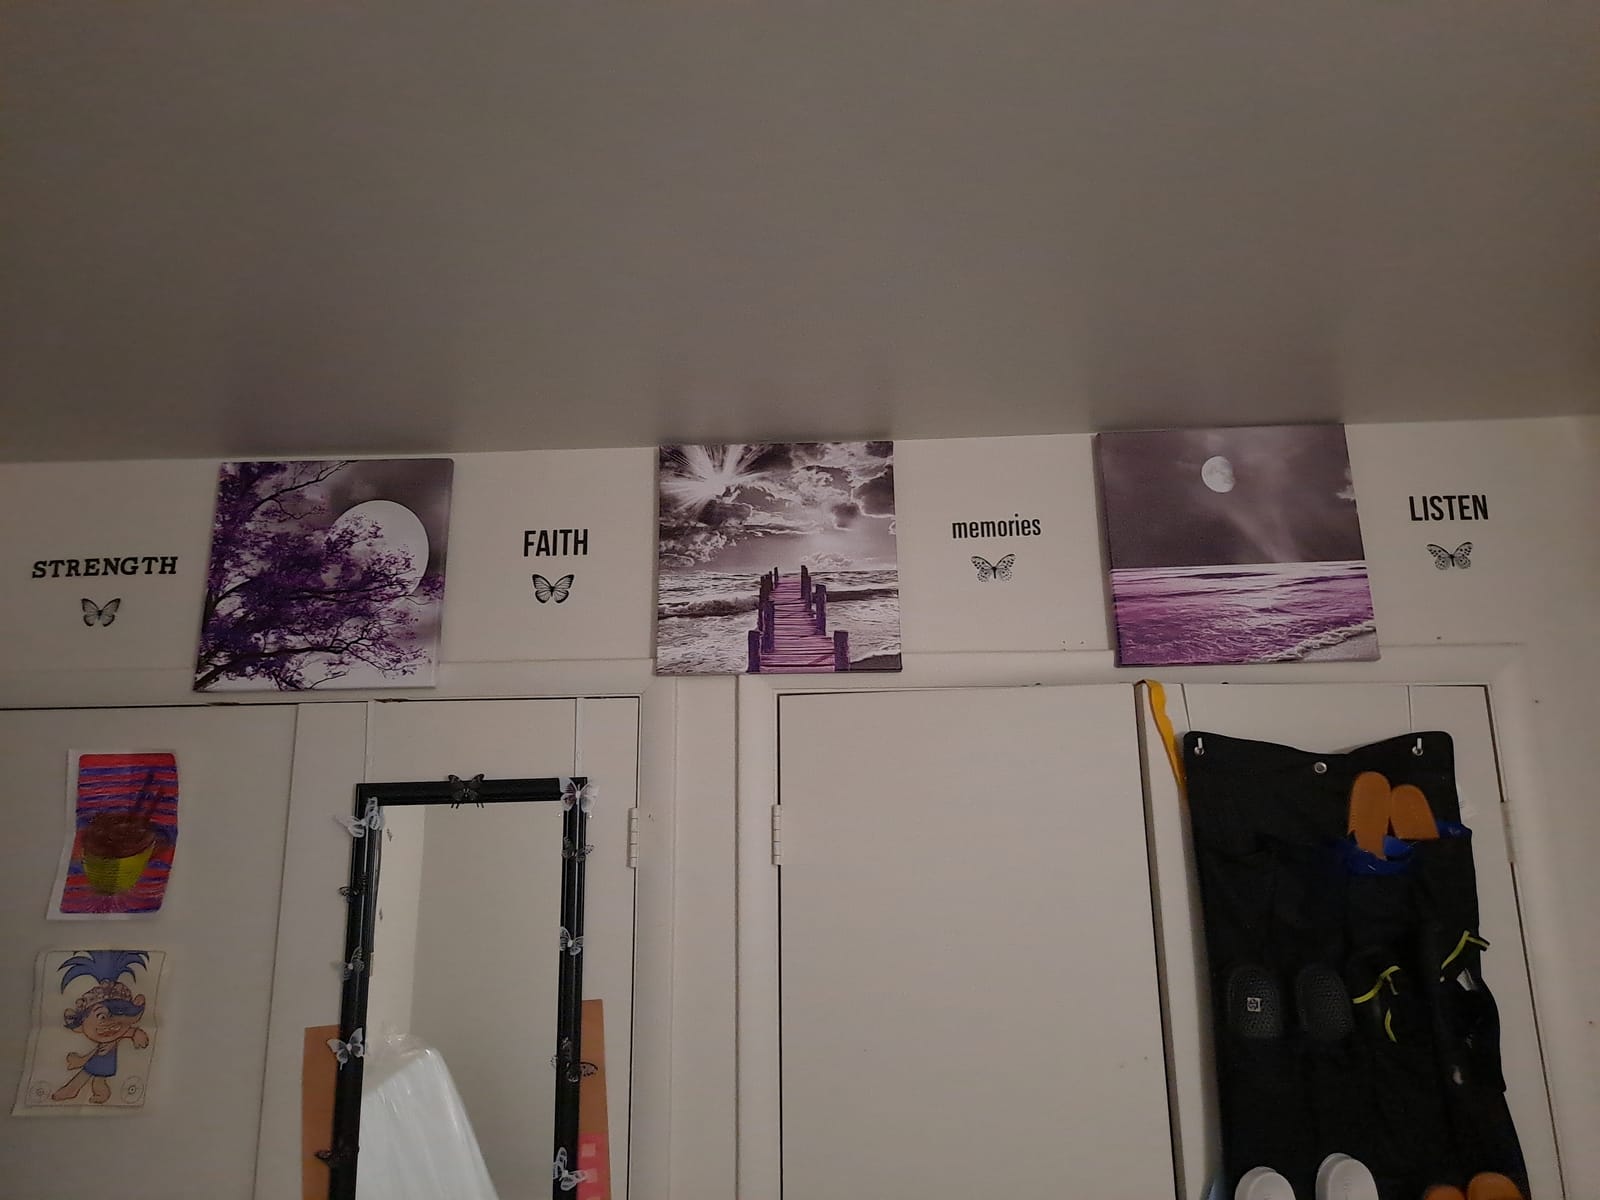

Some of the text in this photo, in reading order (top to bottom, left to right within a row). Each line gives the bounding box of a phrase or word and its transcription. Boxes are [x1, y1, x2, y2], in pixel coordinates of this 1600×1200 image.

[1409, 494, 1489, 521] LISTEN
[951, 512, 1041, 538] memories
[524, 528, 588, 557] FAITH
[32, 556, 178, 579] STRENGTH
